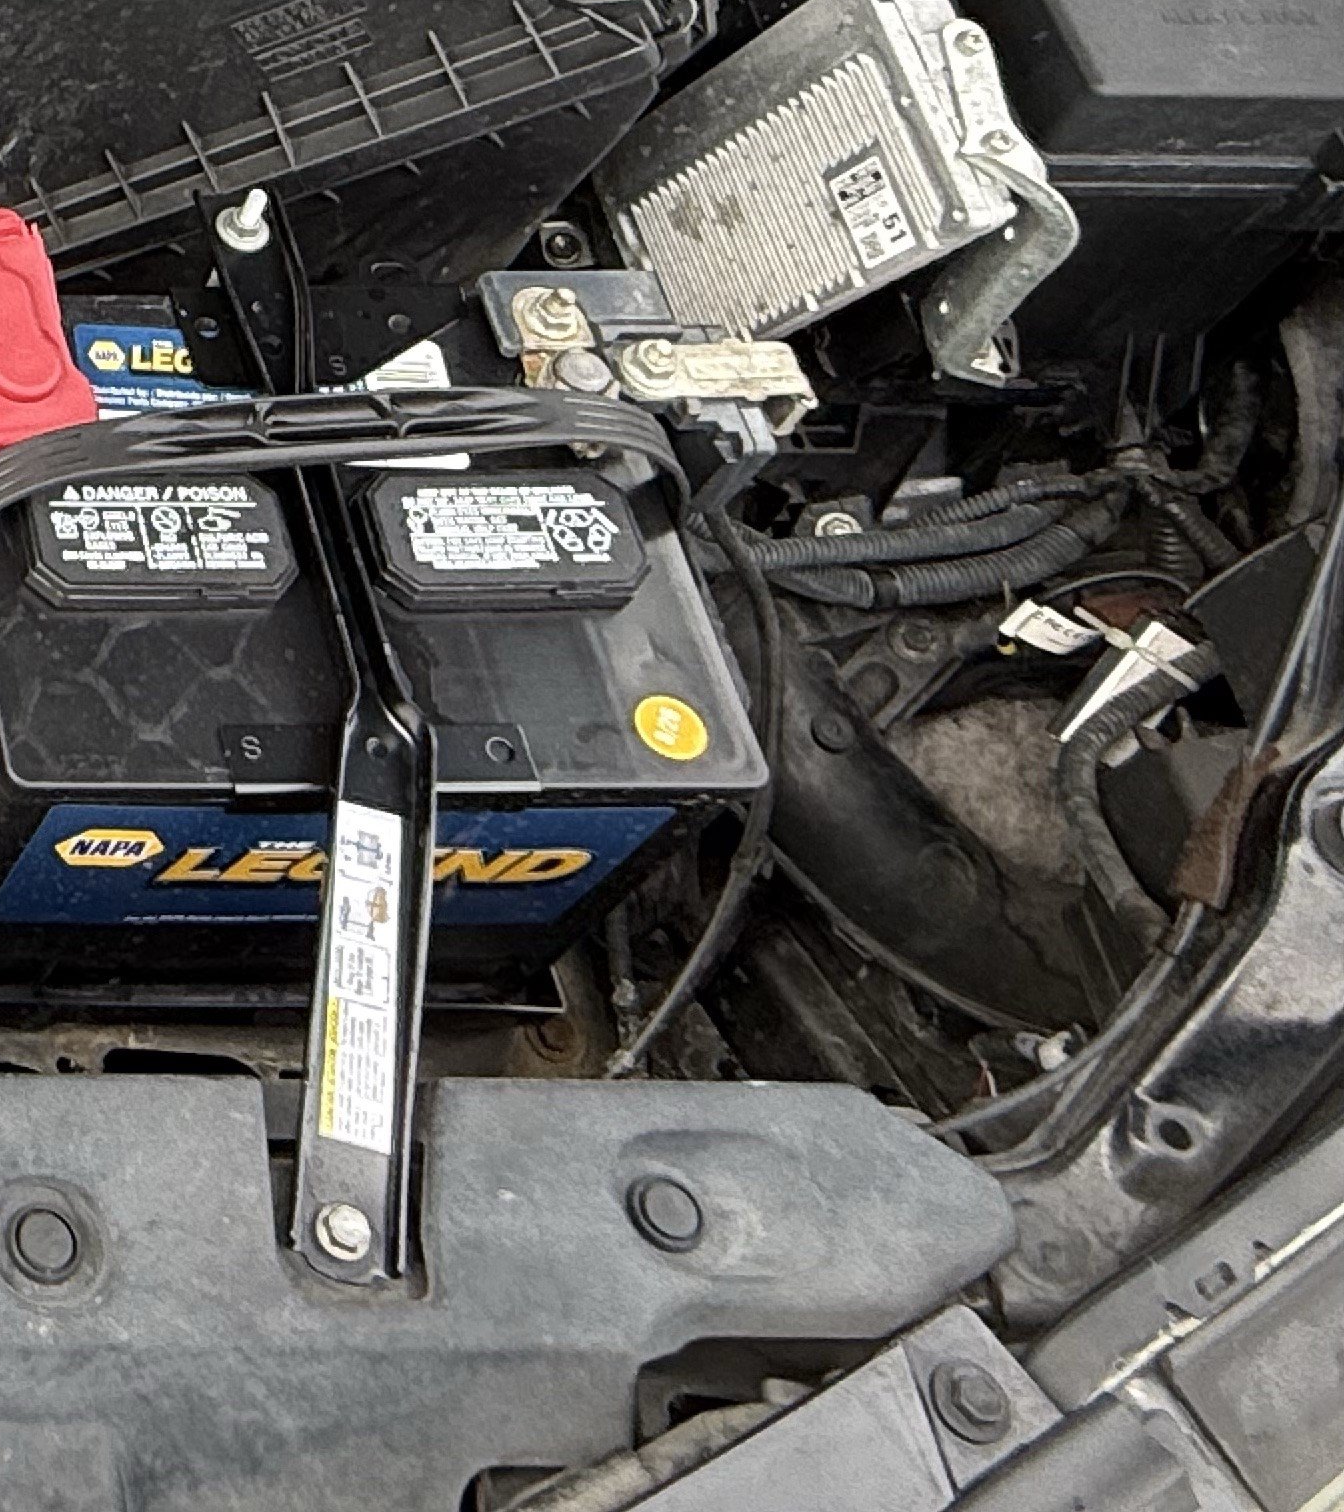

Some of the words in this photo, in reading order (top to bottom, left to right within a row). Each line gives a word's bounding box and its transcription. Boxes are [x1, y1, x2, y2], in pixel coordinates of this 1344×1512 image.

[83, 486, 160, 502] DANGER
[177, 486, 248, 502] POISON
[241, 735, 262, 759] S
[69, 838, 148, 856] NAPA
